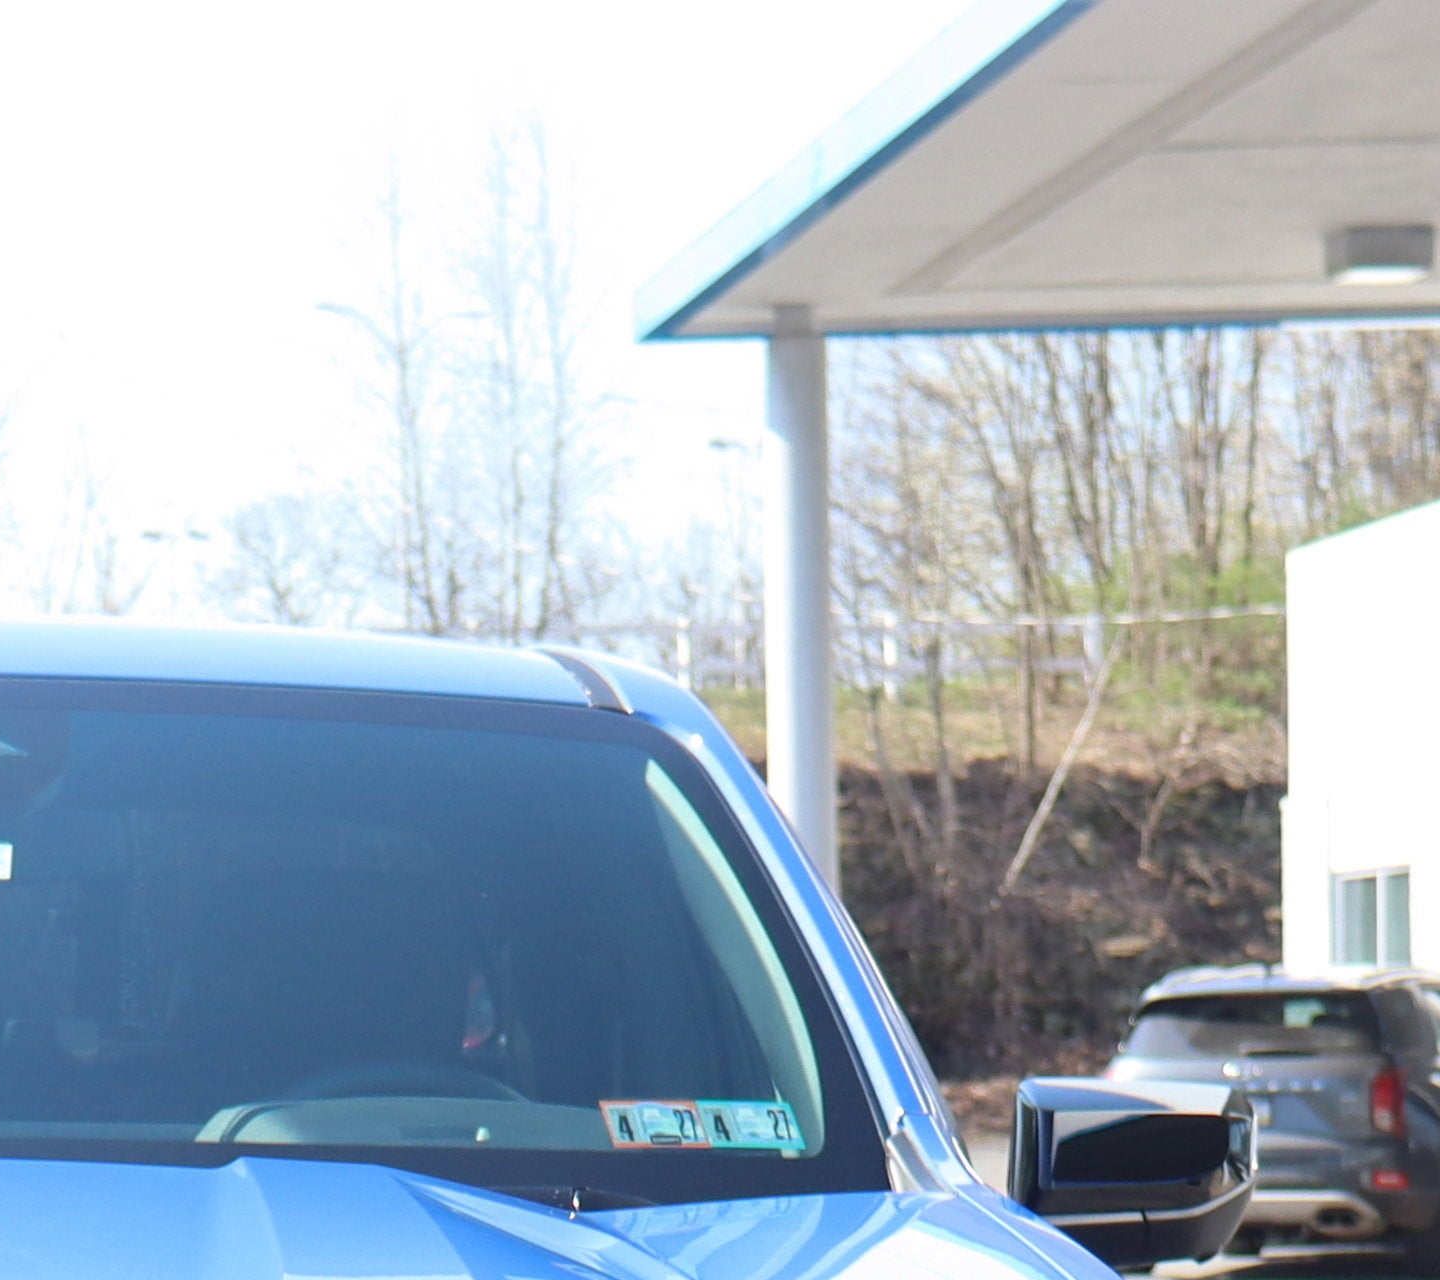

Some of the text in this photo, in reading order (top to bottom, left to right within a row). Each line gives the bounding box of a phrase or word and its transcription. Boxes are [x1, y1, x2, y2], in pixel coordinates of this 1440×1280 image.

[619, 1109, 700, 1142] 4 27
[713, 1109, 794, 1142] 4 27
